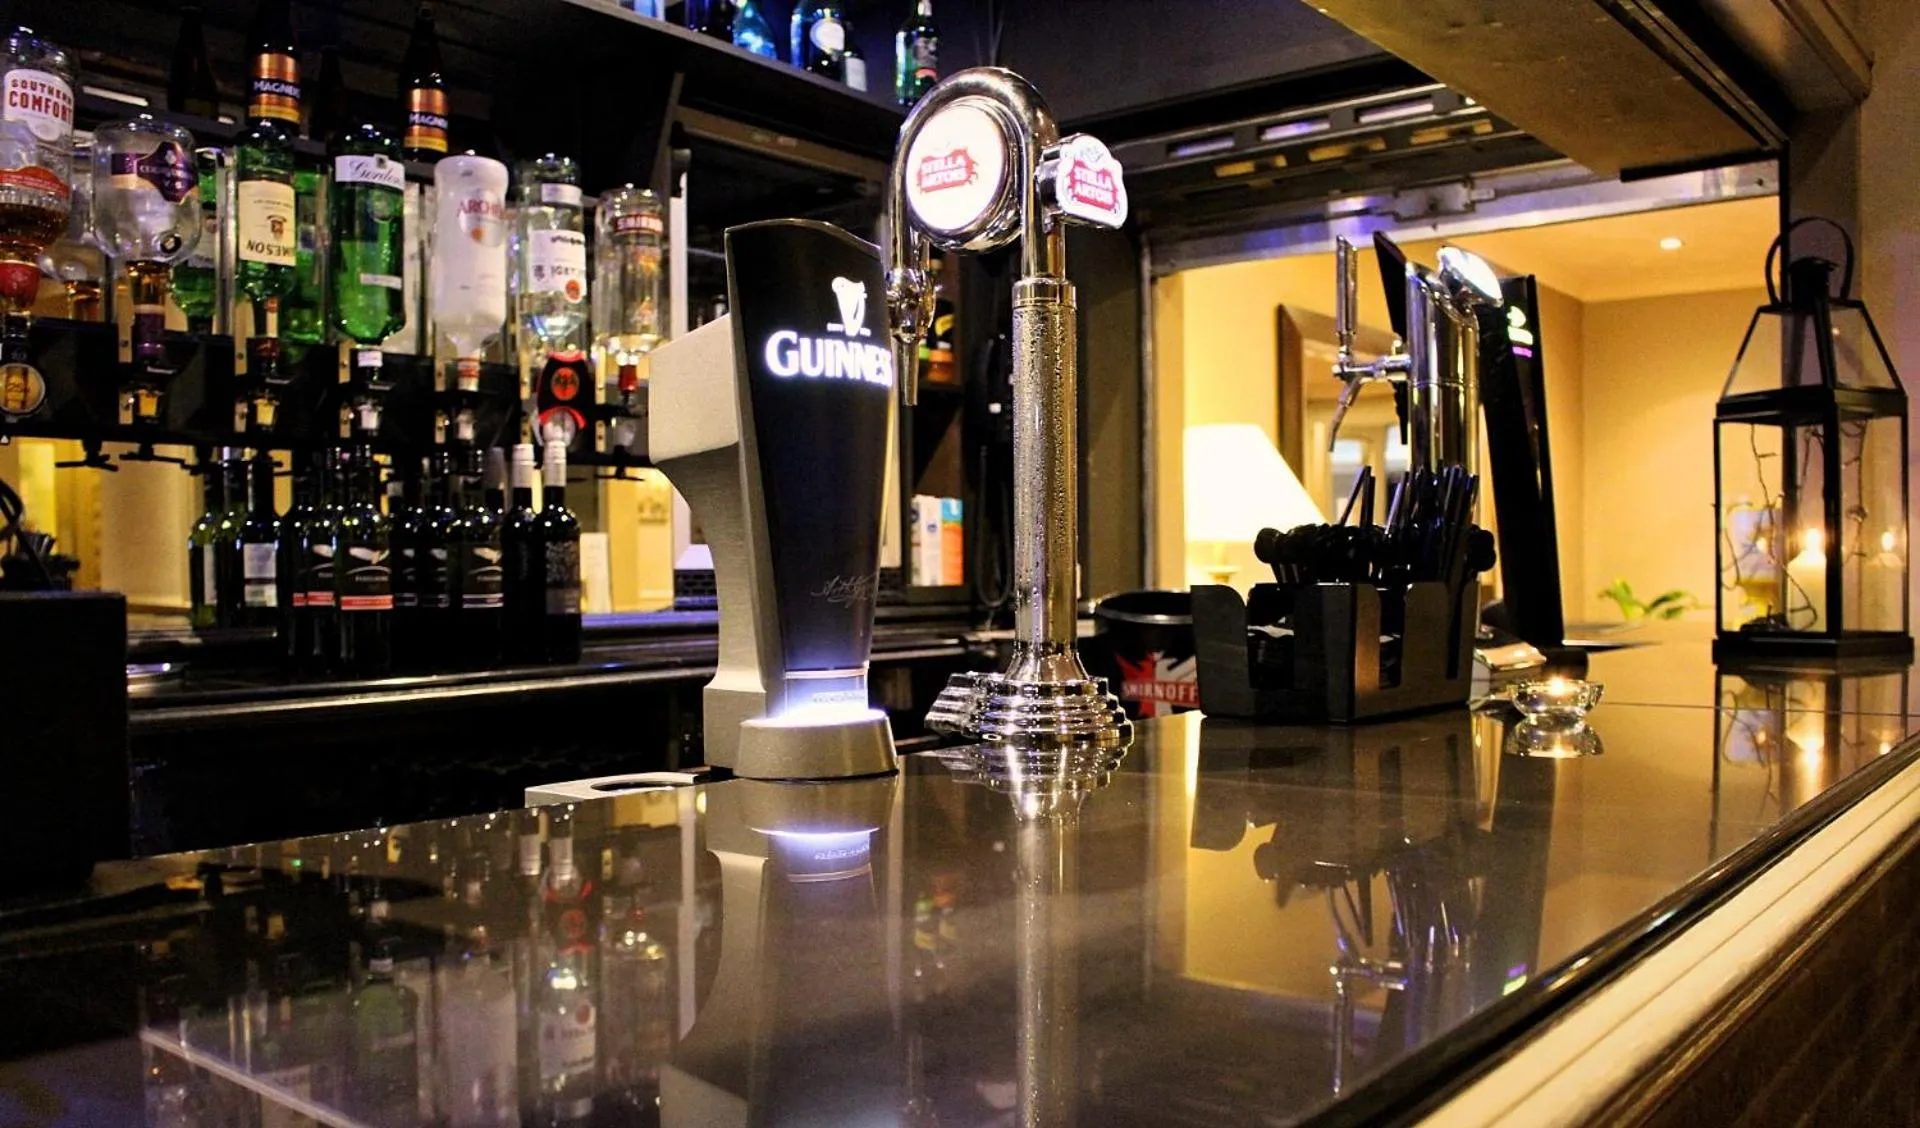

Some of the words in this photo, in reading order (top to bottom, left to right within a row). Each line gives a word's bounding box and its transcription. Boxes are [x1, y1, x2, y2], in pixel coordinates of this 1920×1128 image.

[11, 79, 72, 105] SOUTHERN
[9, 90, 73, 124] COMFORT
[921, 154, 967, 175] STELLA
[1074, 166, 1113, 191] STELLA
[765, 330, 893, 387] GUINNES
